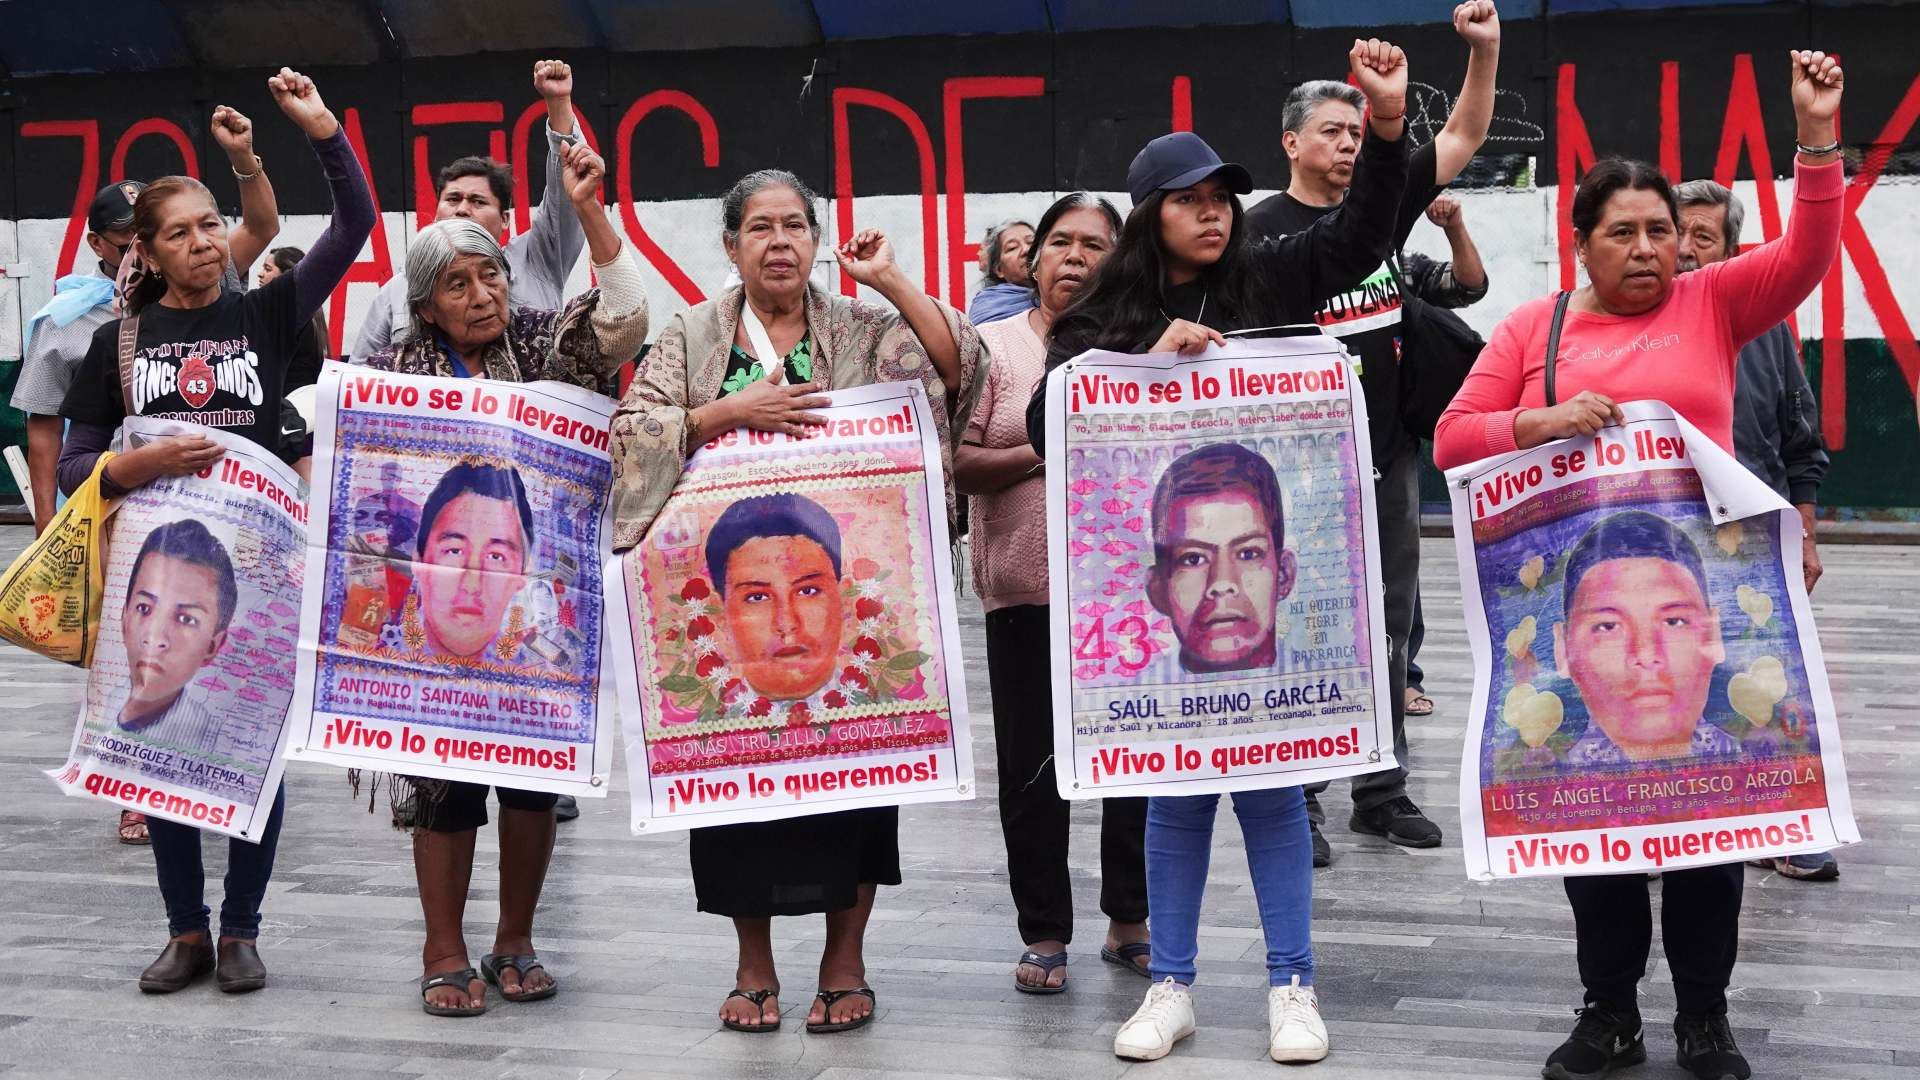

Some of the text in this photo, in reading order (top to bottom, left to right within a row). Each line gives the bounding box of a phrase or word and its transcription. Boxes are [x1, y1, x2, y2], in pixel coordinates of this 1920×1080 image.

[1562, 334, 1680, 362] Calvin Klein
[132, 351, 264, 415] ONCE AÑOS
[186, 379, 208, 394] 43
[1071, 362, 1345, 413] ¡Vivo se lo llevaron!
[191, 407, 255, 426] sombras
[343, 377, 610, 451] ¡Vivo se lo llevaron
[363, 417, 380, 426] Jan
[420, 423, 461, 434] Glasgow,
[786, 405, 914, 443] evaron!
[1075, 424, 1090, 434] Yo,
[1097, 424, 1113, 433] Jan
[1118, 423, 1144, 433] Nimmo,
[1190, 417, 1233, 429] Escocia,
[1238, 415, 1267, 428] quiero
[1271, 413, 1295, 423] saber
[220, 458, 310, 526] llevaron!
[1475, 464, 1544, 518] ¡Vivo
[1551, 449, 1586, 478] se
[1593, 437, 1625, 467] lo
[1553, 488, 1591, 504] Glasgow,
[224, 498, 253, 512] quiero
[1309, 596, 1358, 613] QUERIDO
[1075, 616, 1152, 673] 43
[328, 694, 350, 704] Hijo
[353, 696, 362, 705] de
[368, 698, 416, 713] Magdalena,
[420, 706, 447, 716] Nieto
[450, 709, 460, 717] de
[510, 717, 521, 725] 20
[338, 677, 572, 719] ANTONIO SANTANA MAESTRO
[1108, 679, 1343, 721] SAÚL BRUNO GARCÍA
[673, 719, 926, 758] JONÁS TRUJILLO GONZÁLEZ
[1077, 704, 1366, 736] Hijo de Saúl y Nicanora 18 años Tecoanapa, Guerrero,
[99, 736, 173, 767] RODRÍGUEZ
[181, 758, 245, 786] TLATEMPA
[323, 718, 577, 772] ¡Vivo lo queremos!
[691, 758, 728, 767] Yolanda,
[733, 753, 766, 762] hermano
[770, 751, 779, 759] de
[784, 748, 812, 758] Benito
[840, 743, 859, 752] años
[1091, 727, 1360, 785] ¡Vivo lo queremos!
[84, 772, 236, 828] queremos!
[667, 754, 938, 813] ¡Vivo lo queremos!
[1492, 767, 1816, 812] LUÍS ÁNGEL FRANCISCO ARZOLA
[1518, 813, 1541, 823] Hijo
[1545, 811, 1557, 819] de
[1562, 808, 1601, 818] Lorenzo
[1617, 804, 1657, 814] Benigna
[1672, 801, 1683, 809] 20
[1687, 799, 1709, 808] años
[1724, 796, 1741, 804] San
[1506, 815, 1815, 875] ¡Vivo lo queremos!
